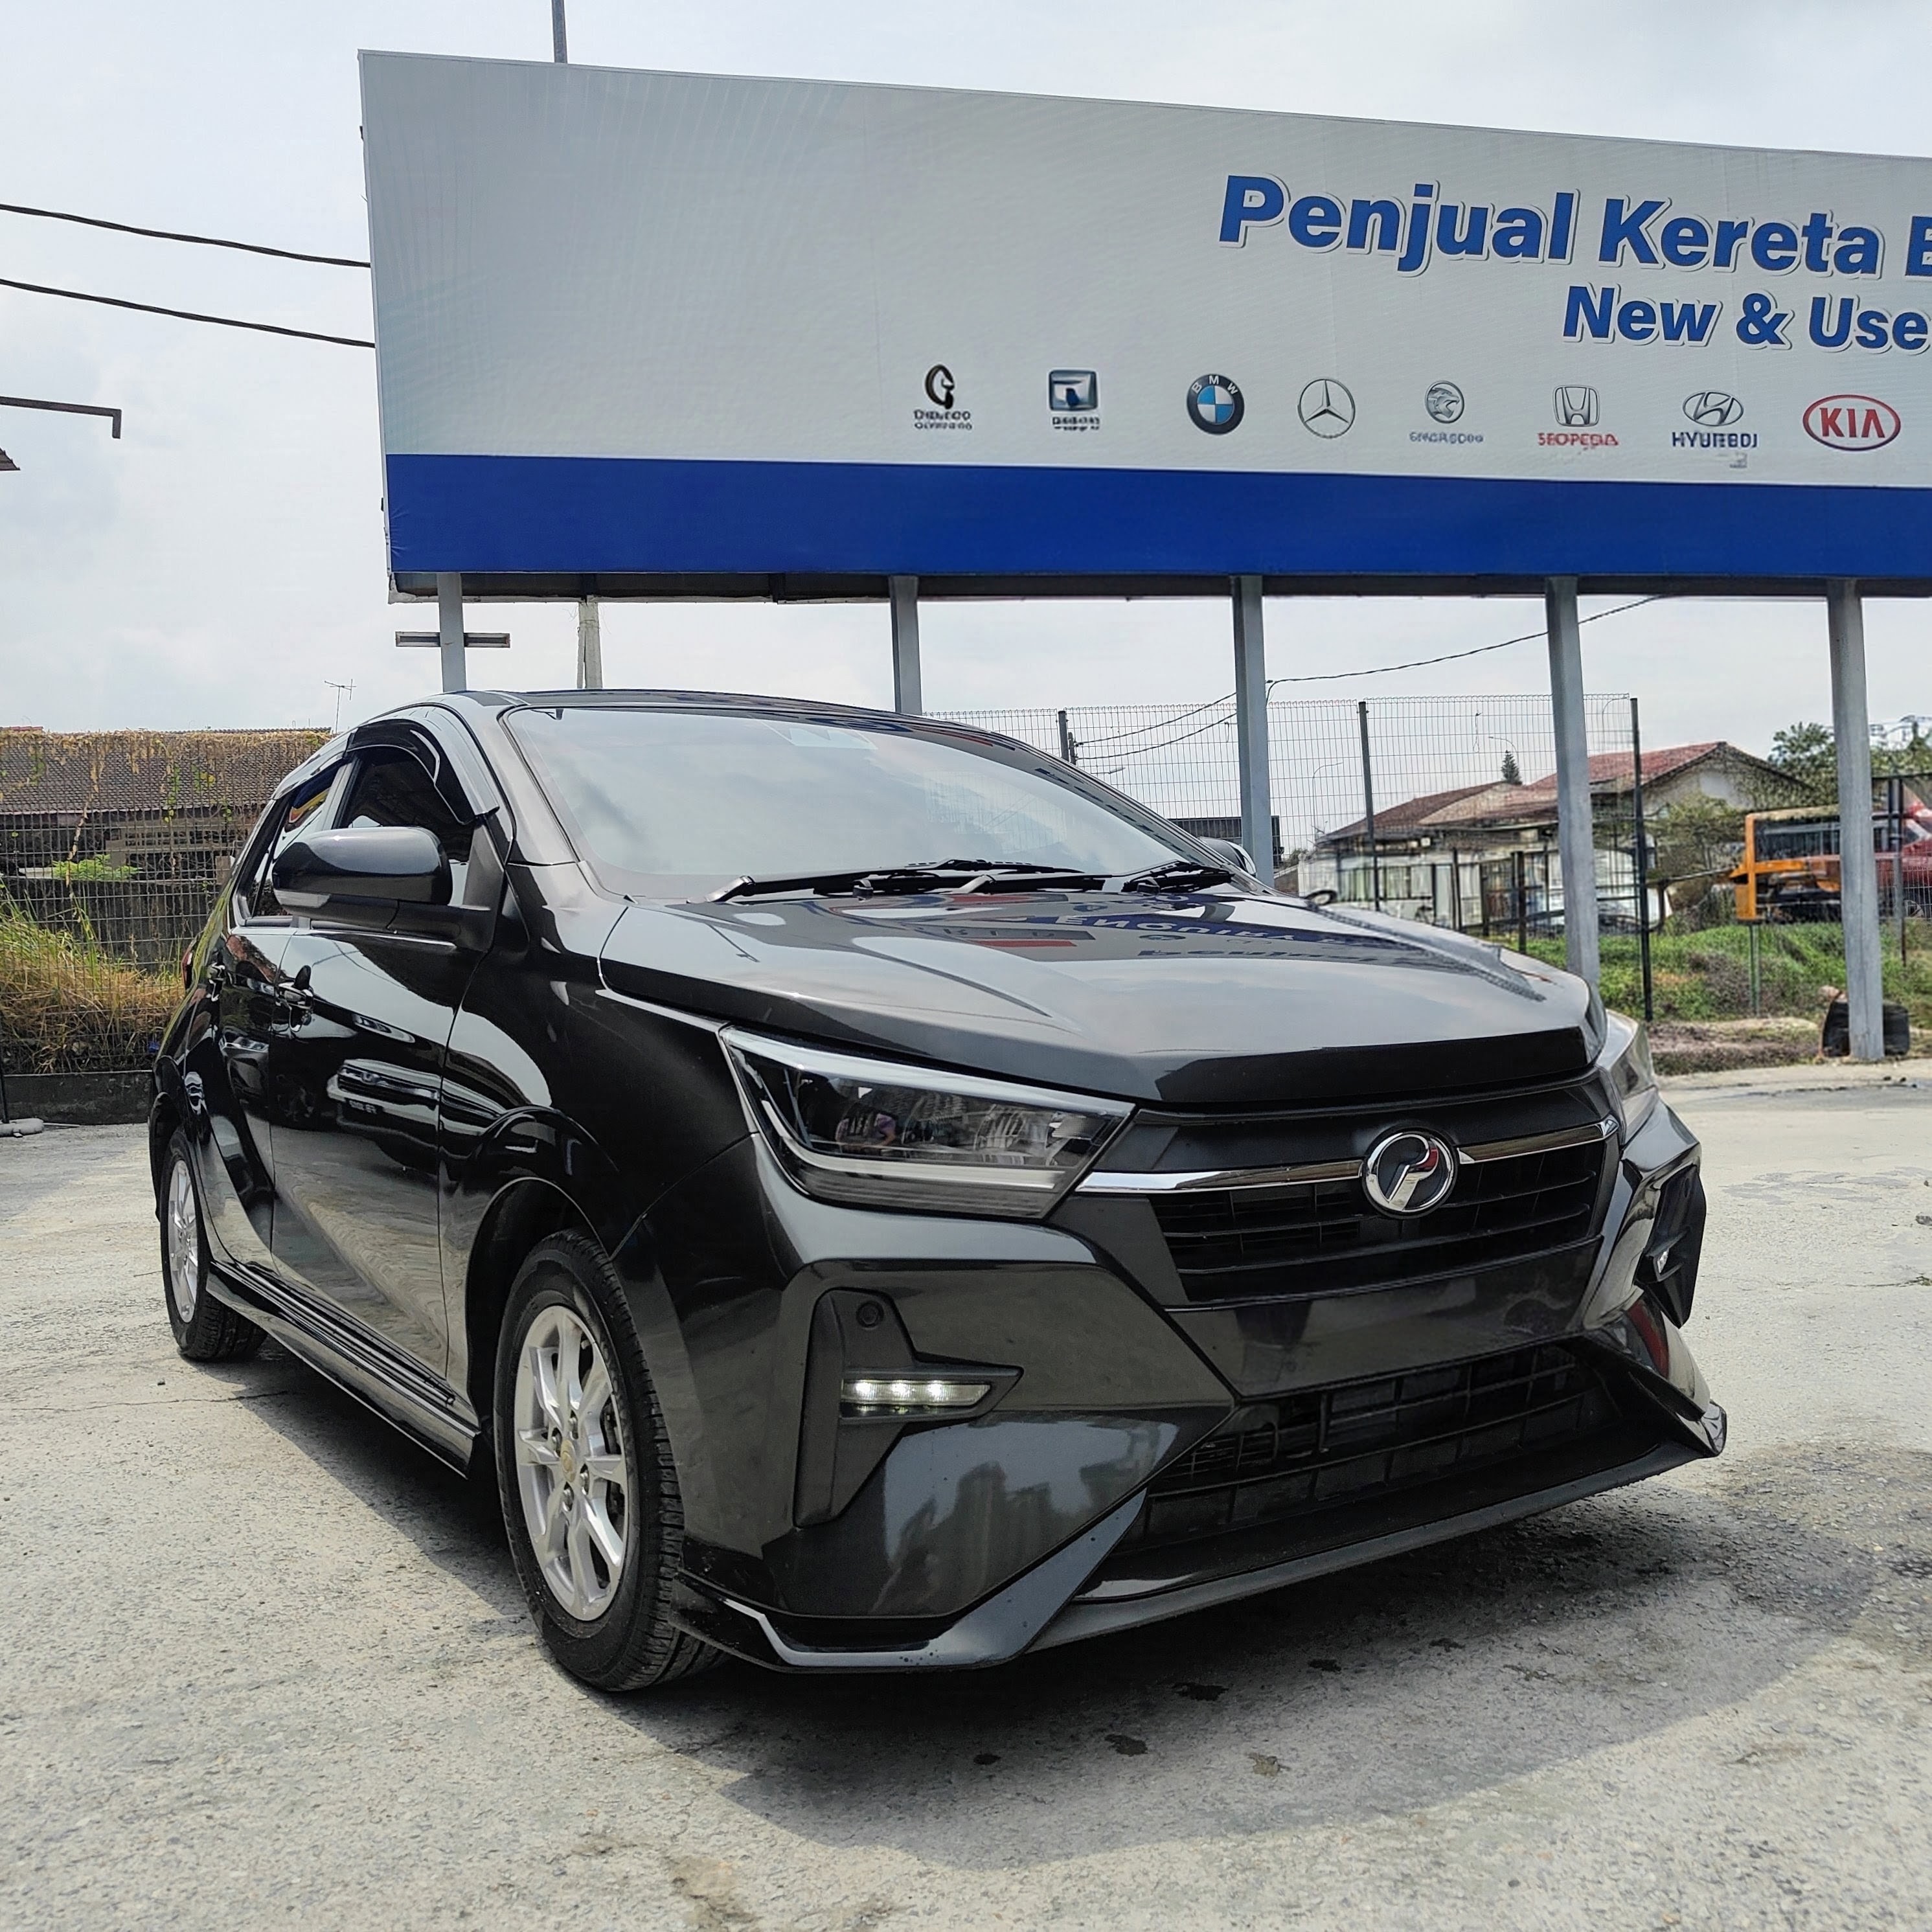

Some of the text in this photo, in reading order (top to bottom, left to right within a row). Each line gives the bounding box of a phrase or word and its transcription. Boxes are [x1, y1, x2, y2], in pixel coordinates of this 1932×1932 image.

[1218, 174, 1576, 273] Penjual
[1598, 198, 1880, 275] Kereta
[1563, 285, 1717, 342] New
[1735, 293, 1789, 345] &
[1191, 375, 1238, 394] BMW
[1819, 407, 1886, 438] KIA
